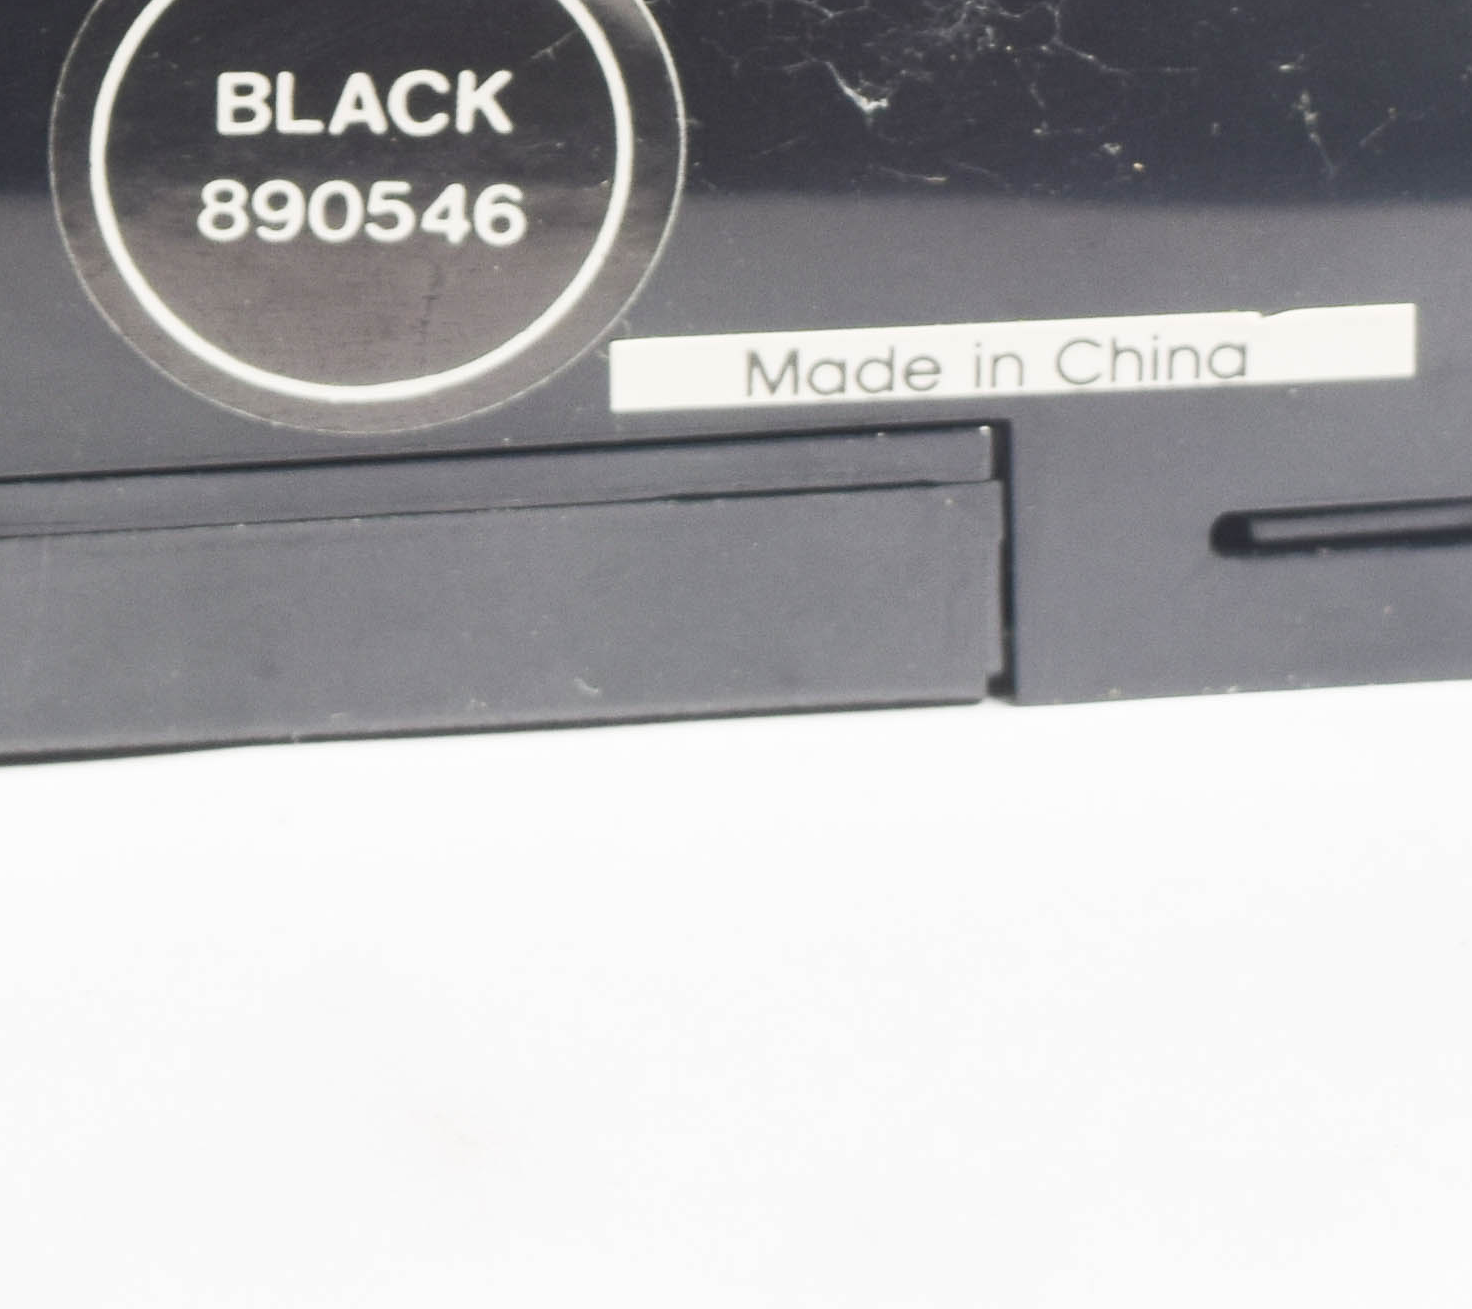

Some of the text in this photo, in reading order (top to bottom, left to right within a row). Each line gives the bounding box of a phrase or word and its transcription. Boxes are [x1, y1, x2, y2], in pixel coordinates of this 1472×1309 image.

[216, 69, 514, 137] BLACK
[196, 178, 528, 248] 890546
[747, 339, 1247, 396] Made in China
